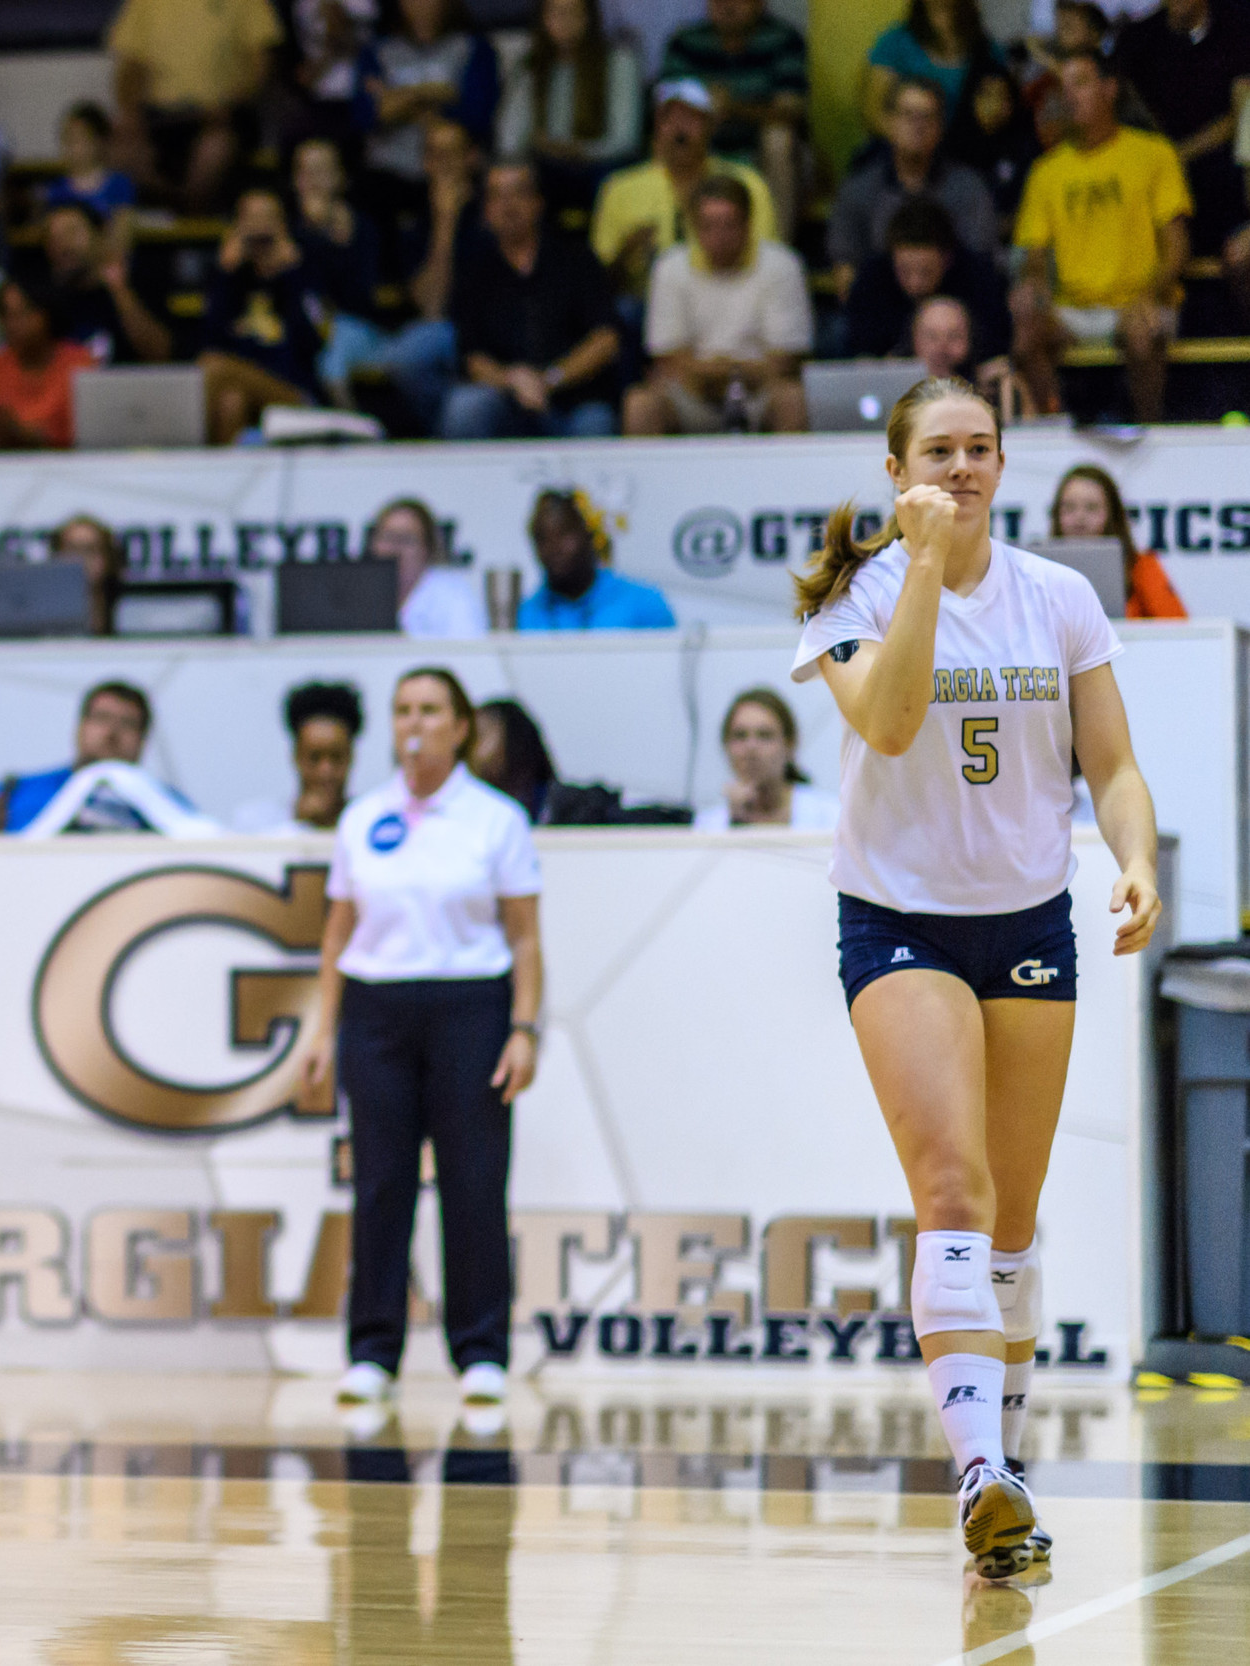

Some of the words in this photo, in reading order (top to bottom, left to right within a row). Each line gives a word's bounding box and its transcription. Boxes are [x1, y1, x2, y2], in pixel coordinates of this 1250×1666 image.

[1000, 667, 1060, 701] TECH
[961, 716, 999, 785] 5
[534, 1310, 1107, 1364] VOLLEYBL
